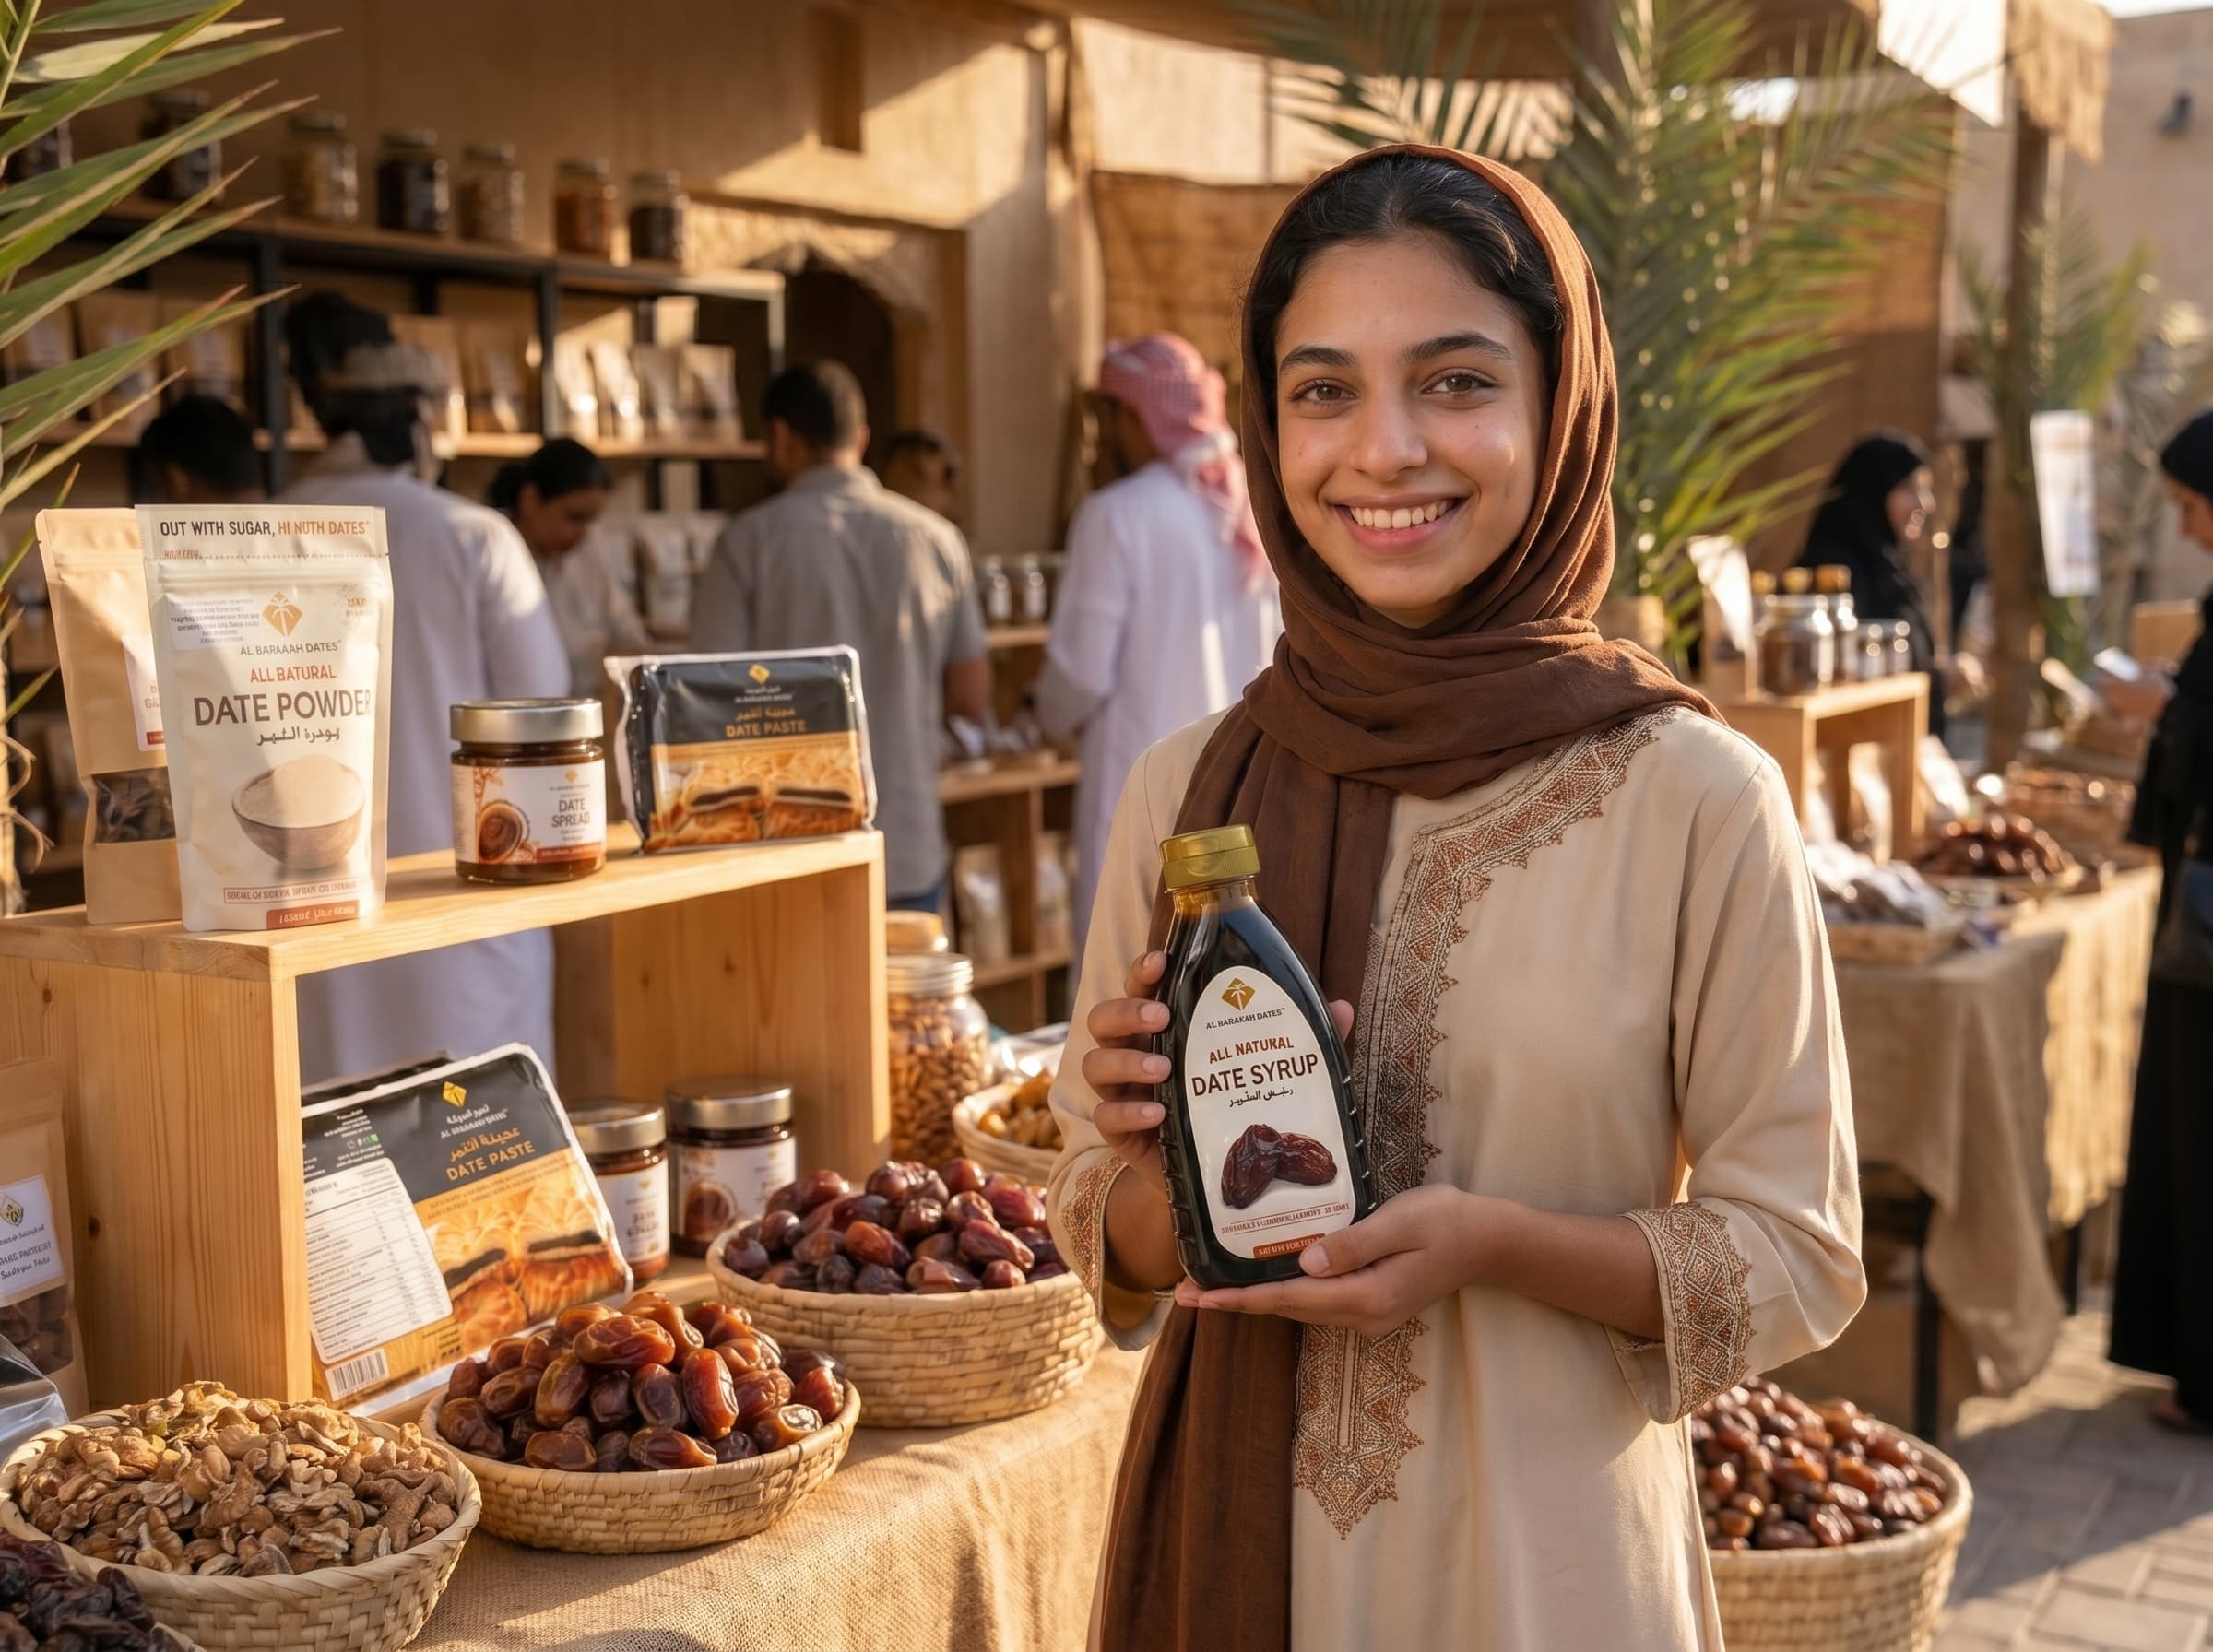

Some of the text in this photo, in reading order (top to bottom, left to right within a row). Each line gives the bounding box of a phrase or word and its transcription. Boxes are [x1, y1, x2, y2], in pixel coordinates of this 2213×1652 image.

[160, 521, 186, 536] OUT
[191, 521, 225, 536] WITH
[229, 520, 275, 537] SUGAR,
[240, 646, 254, 655] AL
[250, 667, 275, 683] ALL
[194, 693, 270, 726] DATE
[726, 719, 806, 738] DATE PASTE
[558, 797, 586, 812] DATE
[551, 811, 591, 828] SPREAD
[1206, 1021, 1217, 1030] AL
[1209, 1046, 1233, 1064] ALL
[1191, 1053, 1319, 1097] DATE SYRUP
[445, 1140, 536, 1181] DATE PASTE
